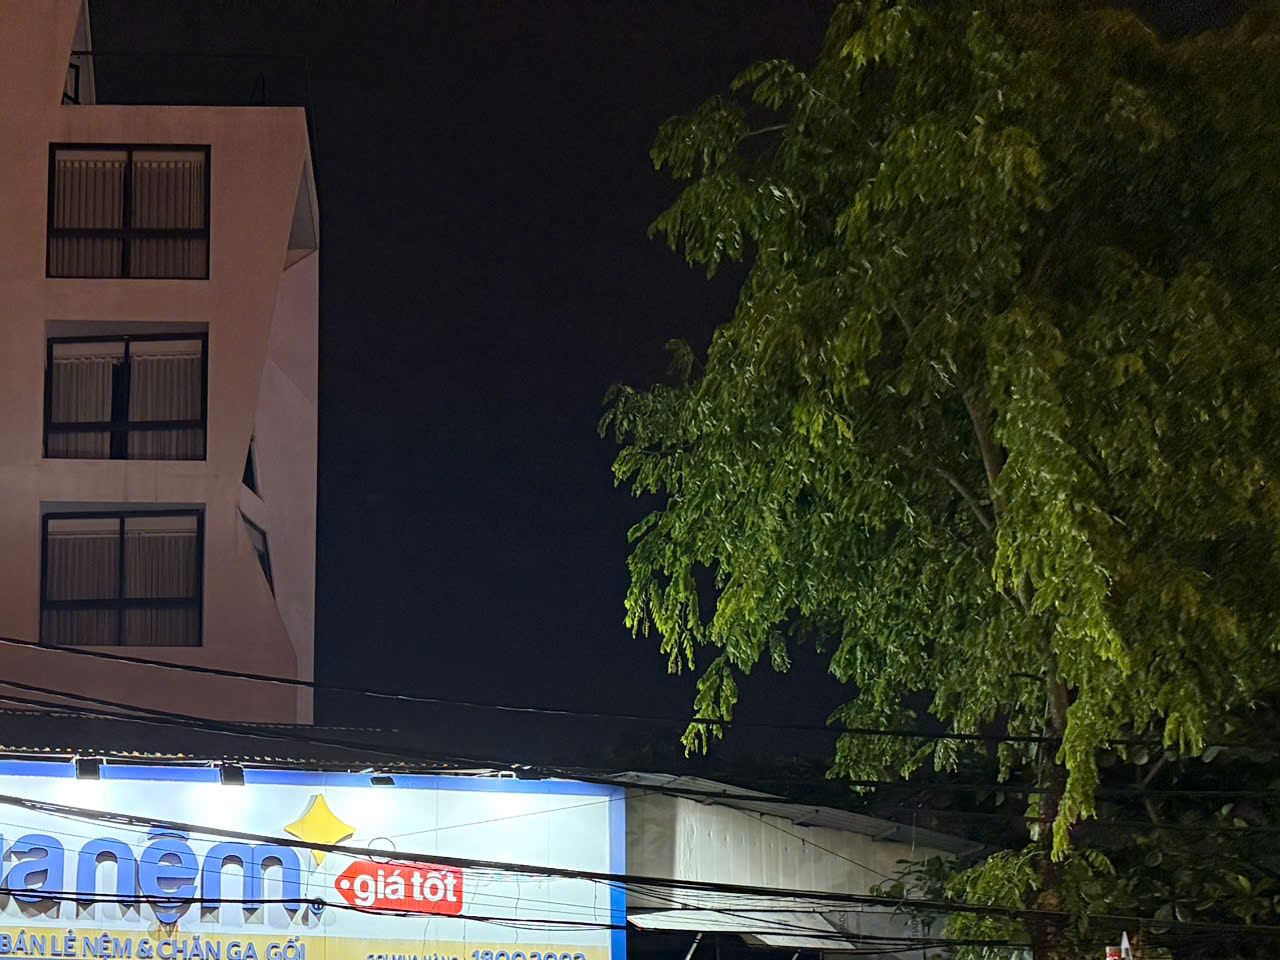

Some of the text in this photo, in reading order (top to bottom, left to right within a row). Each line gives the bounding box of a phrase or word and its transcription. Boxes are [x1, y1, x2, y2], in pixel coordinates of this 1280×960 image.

[354, 868, 457, 906] giá tốt
[0, 930, 46, 955] BÁN
[51, 929, 76, 957] LẺ
[83, 932, 131, 960] NỆM
[157, 935, 220, 960] CHĂN
